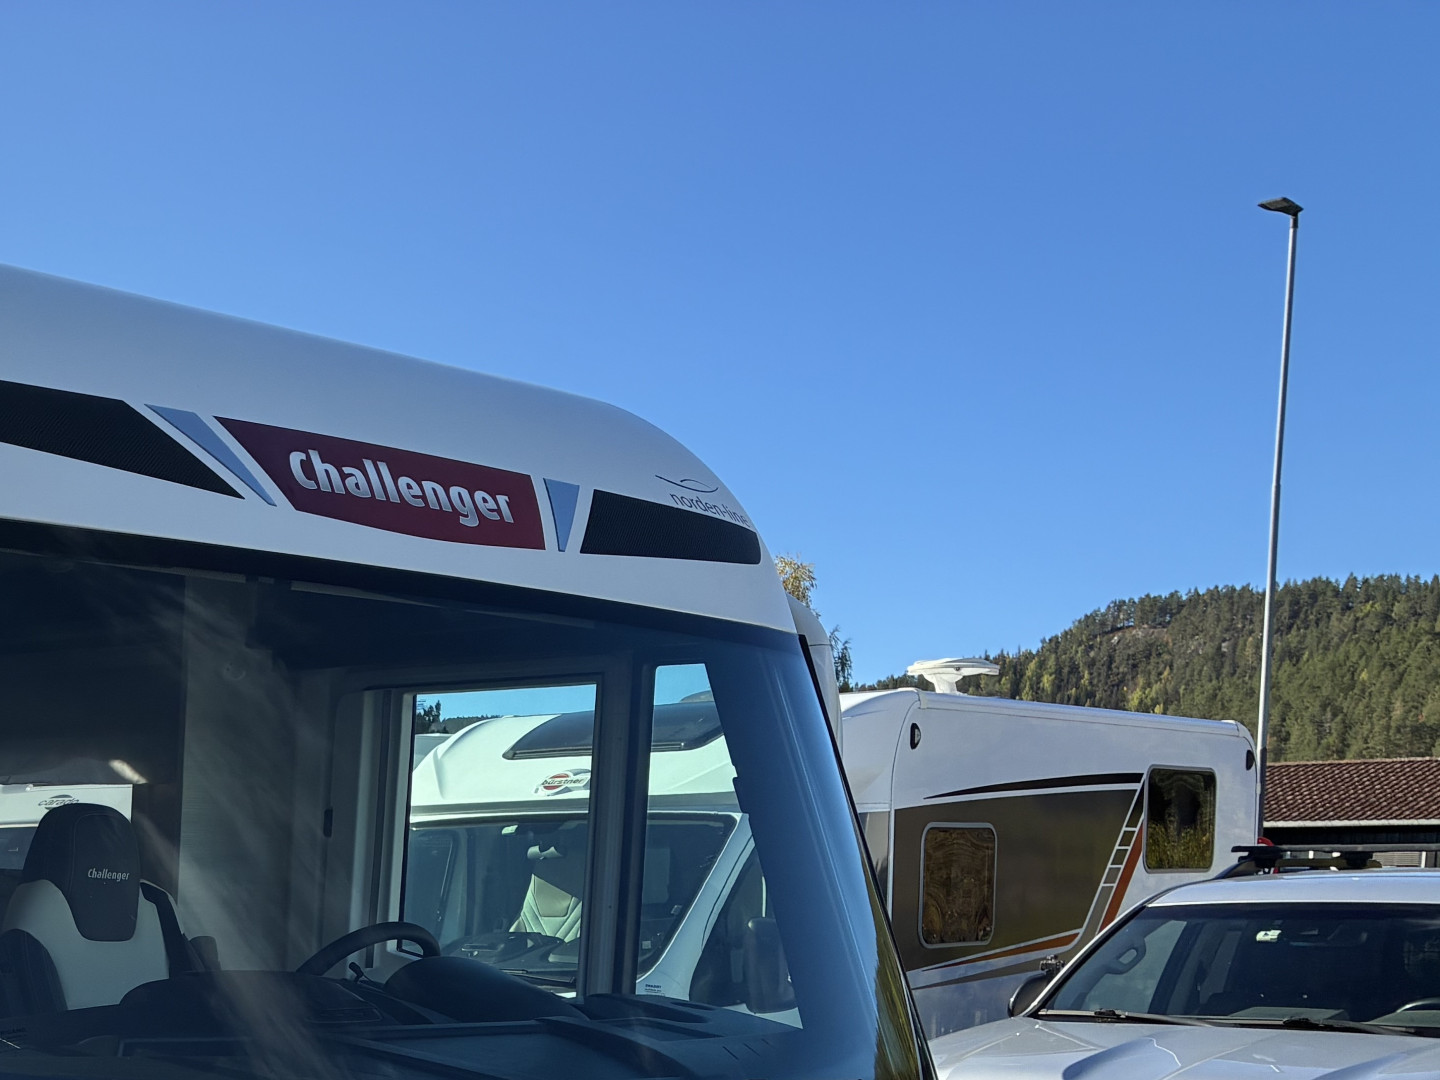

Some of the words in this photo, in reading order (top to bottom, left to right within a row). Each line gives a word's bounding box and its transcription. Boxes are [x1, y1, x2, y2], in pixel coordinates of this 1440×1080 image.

[288, 448, 514, 528] Challenger
[669, 493, 751, 528] norden-line
[87, 867, 130, 882] Challenger
